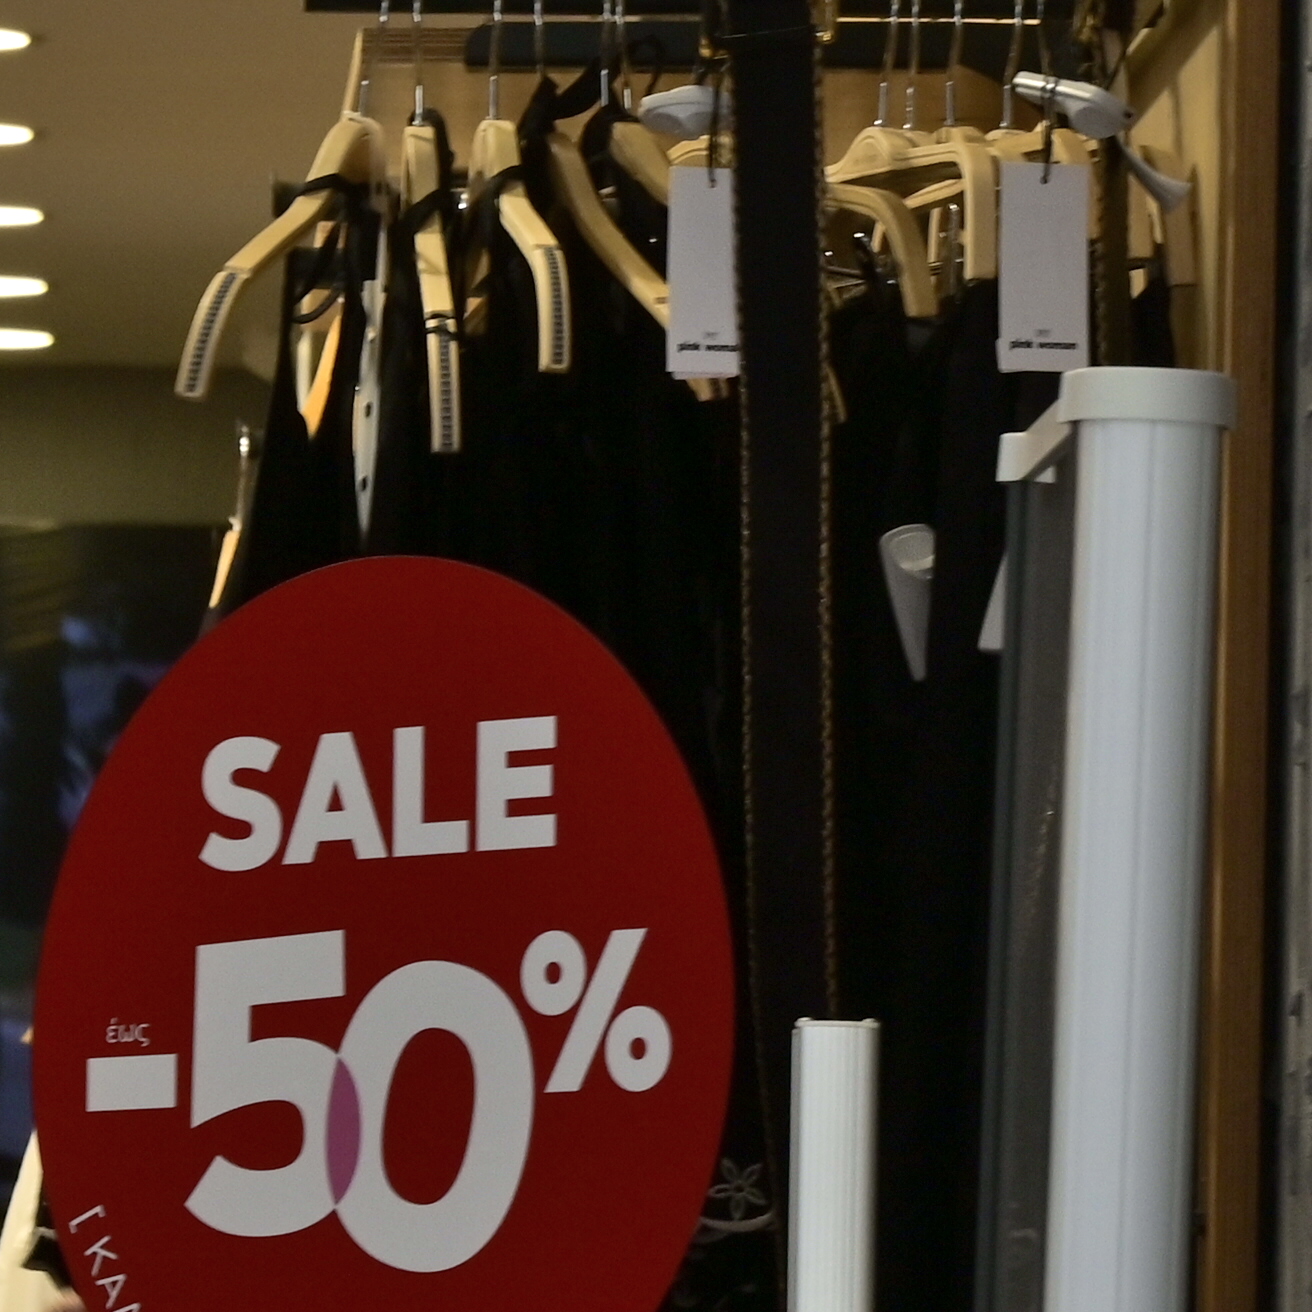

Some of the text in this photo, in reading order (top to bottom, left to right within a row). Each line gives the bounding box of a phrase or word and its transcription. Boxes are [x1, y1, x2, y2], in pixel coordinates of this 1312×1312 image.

[198, 715, 558, 872] SALE
[85, 927, 673, 1274] -50%
[105, 1017, 151, 1047] έως
